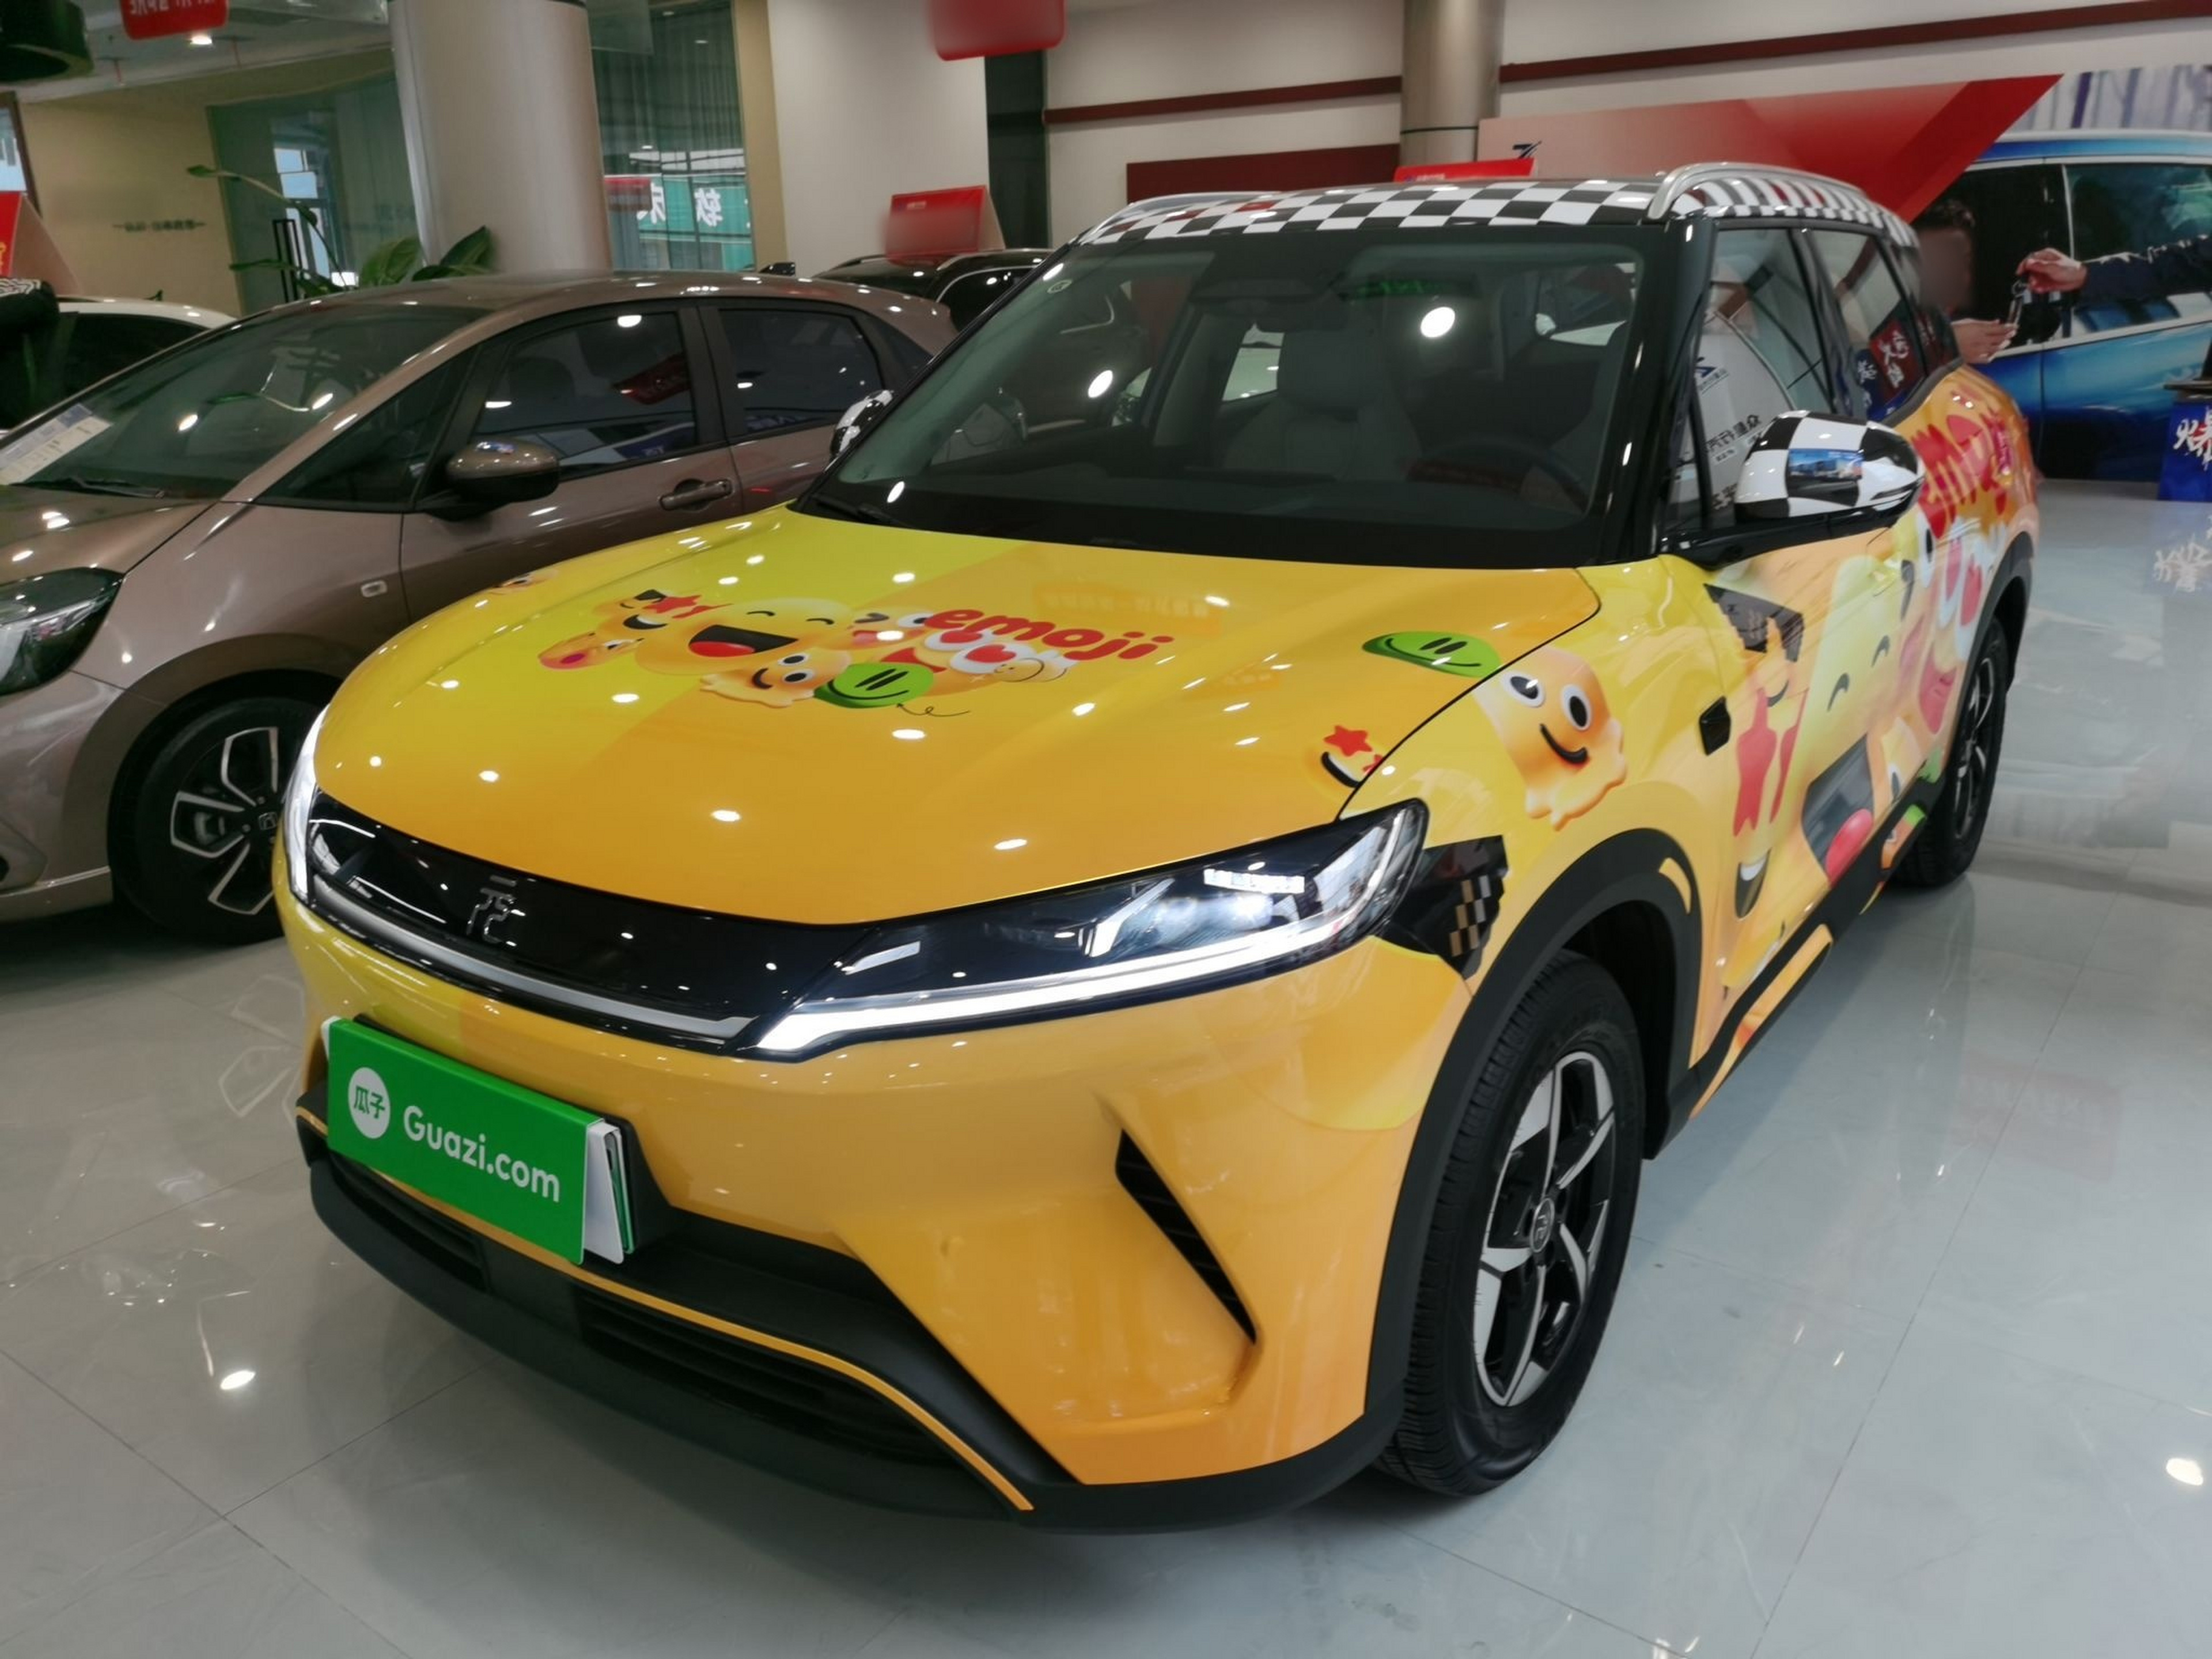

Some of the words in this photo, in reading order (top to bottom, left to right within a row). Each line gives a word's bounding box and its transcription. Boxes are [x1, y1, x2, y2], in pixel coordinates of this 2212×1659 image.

[925, 609, 1173, 660] emoji
[354, 1086, 385, 1119] 瓜子
[404, 1105, 559, 1202] Guazi.com
